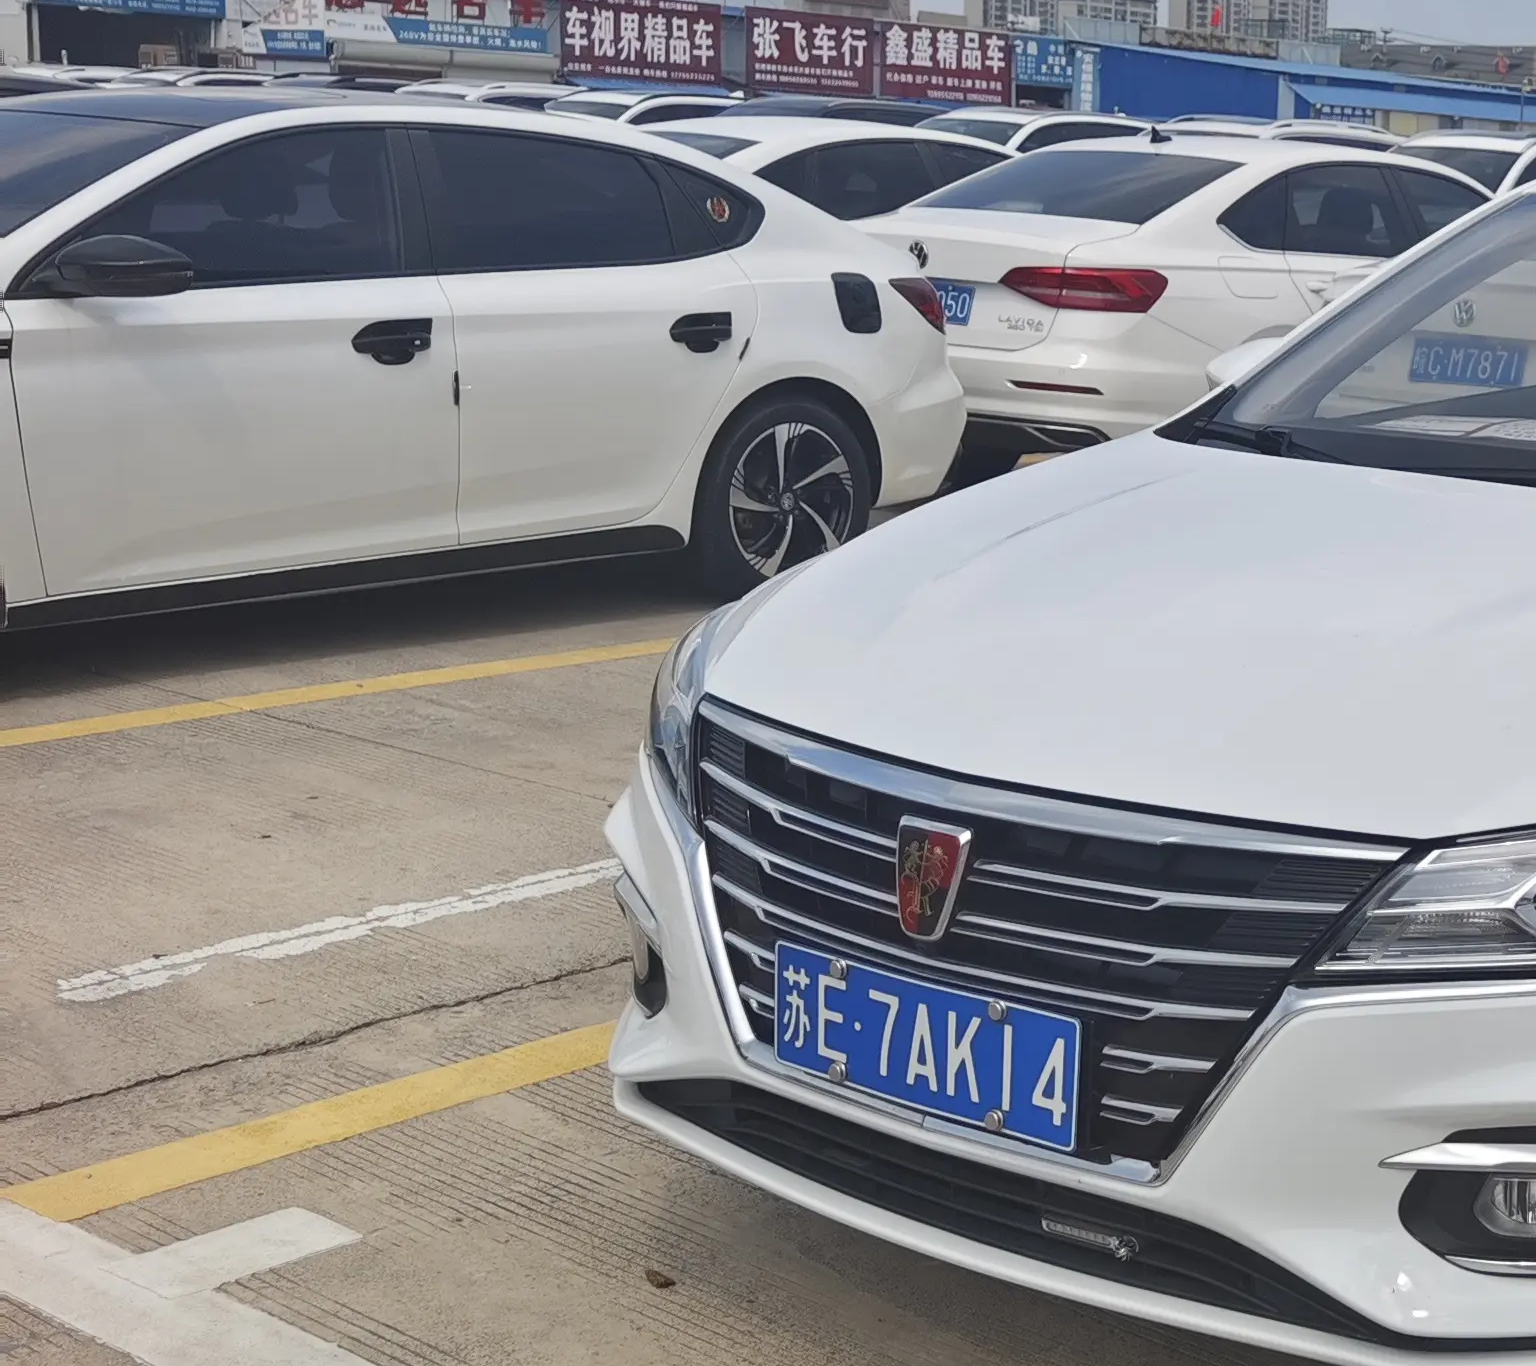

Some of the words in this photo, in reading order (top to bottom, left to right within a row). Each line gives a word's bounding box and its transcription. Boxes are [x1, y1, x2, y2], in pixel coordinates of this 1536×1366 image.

[564, 6, 715, 66] 车视界精品车
[752, 16, 868, 68] 张飞车行
[886, 24, 1006, 75] 鑫盛精品车
[998, 315, 1044, 327] LAVIDA
